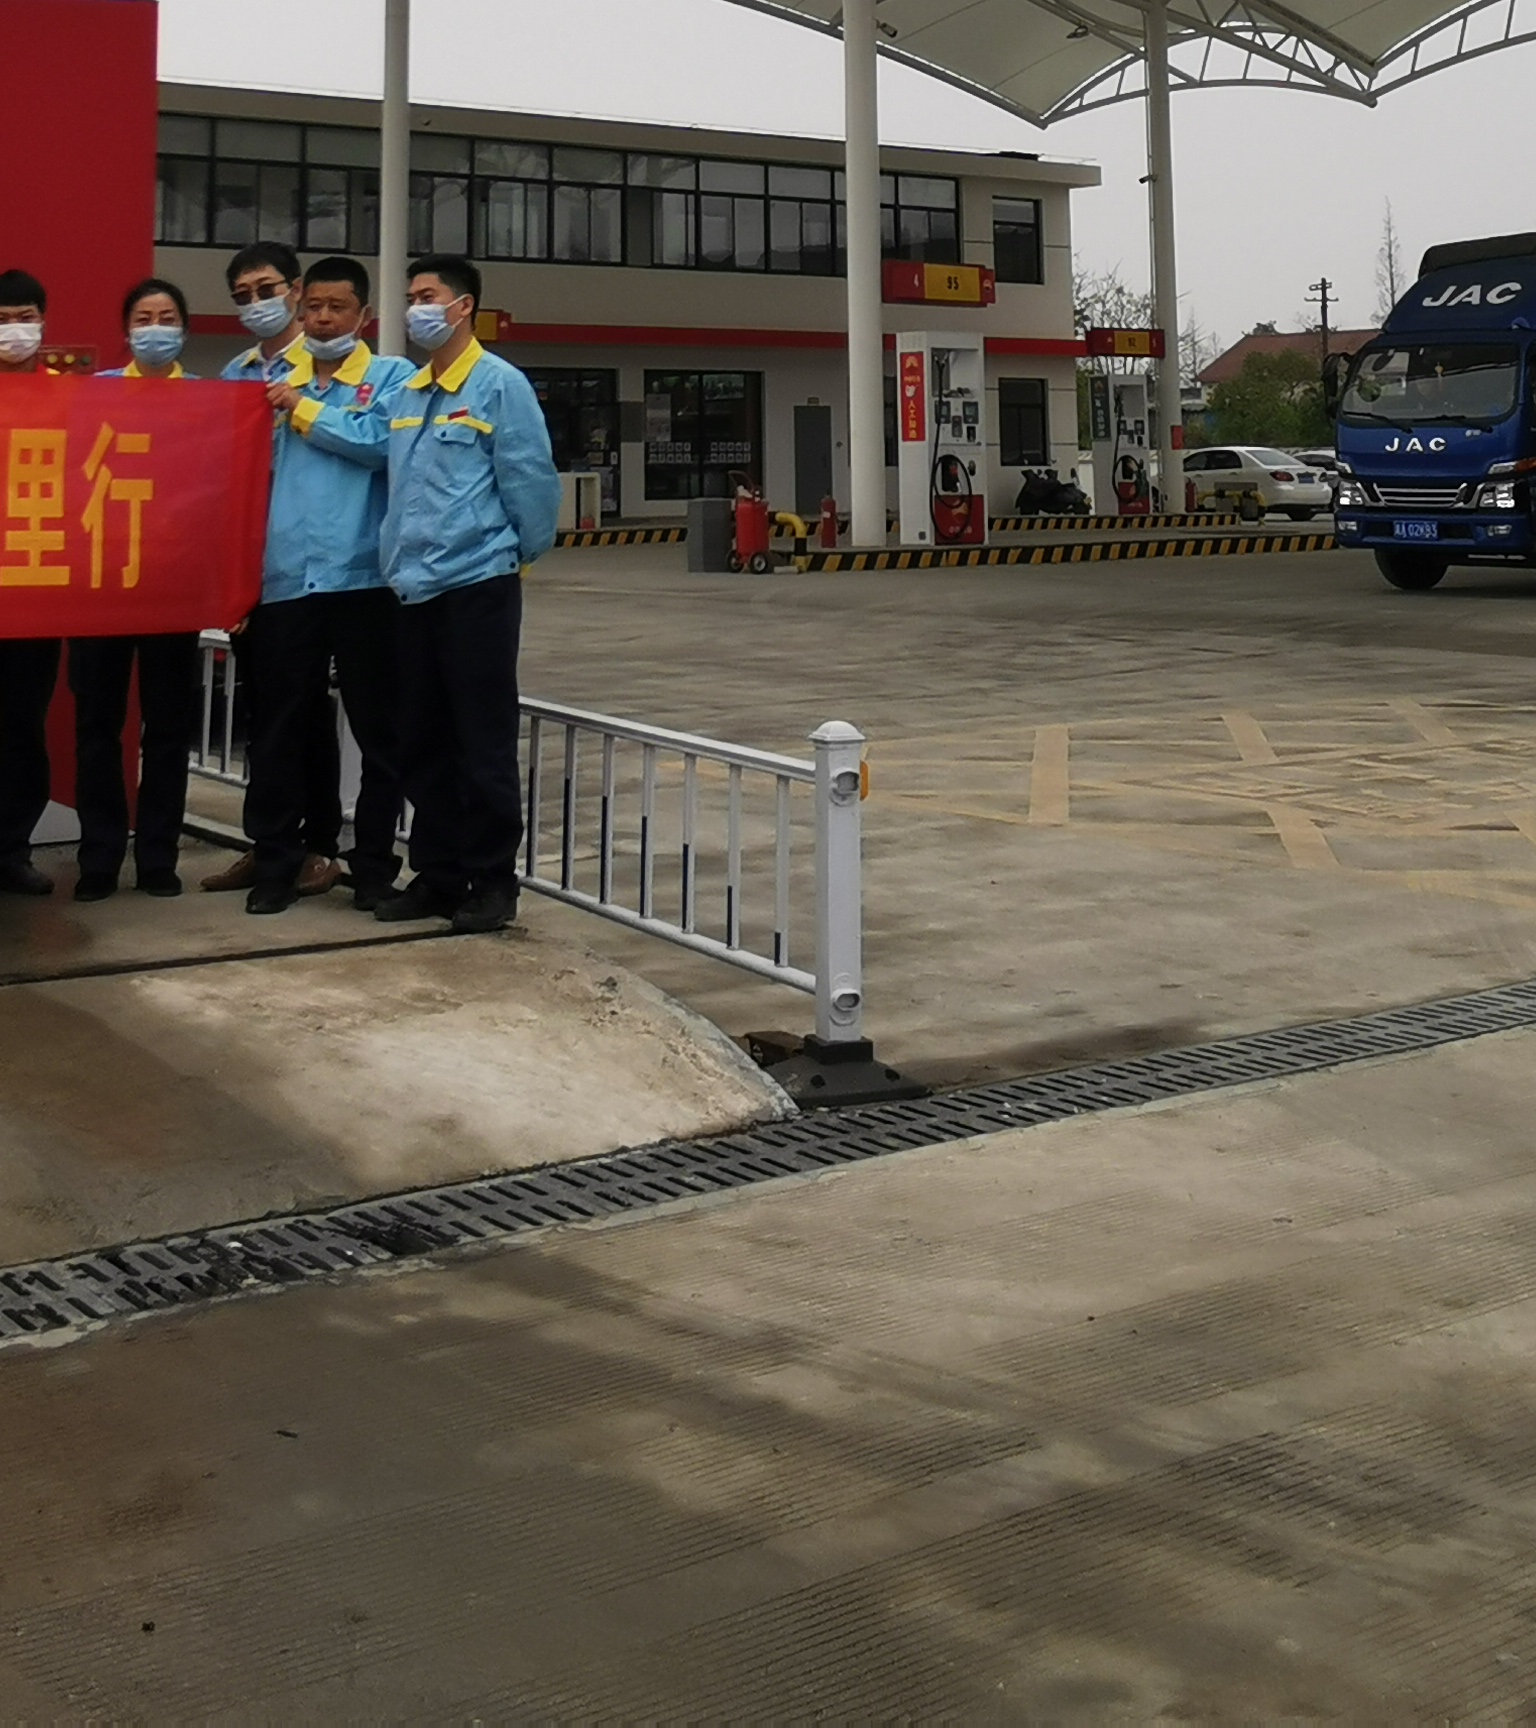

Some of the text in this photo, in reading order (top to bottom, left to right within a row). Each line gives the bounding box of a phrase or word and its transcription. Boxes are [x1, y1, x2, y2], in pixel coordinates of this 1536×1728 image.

[947, 275, 959, 290] 95
[1422, 282, 1522, 307] JAC
[1385, 437, 1446, 452] JAC
